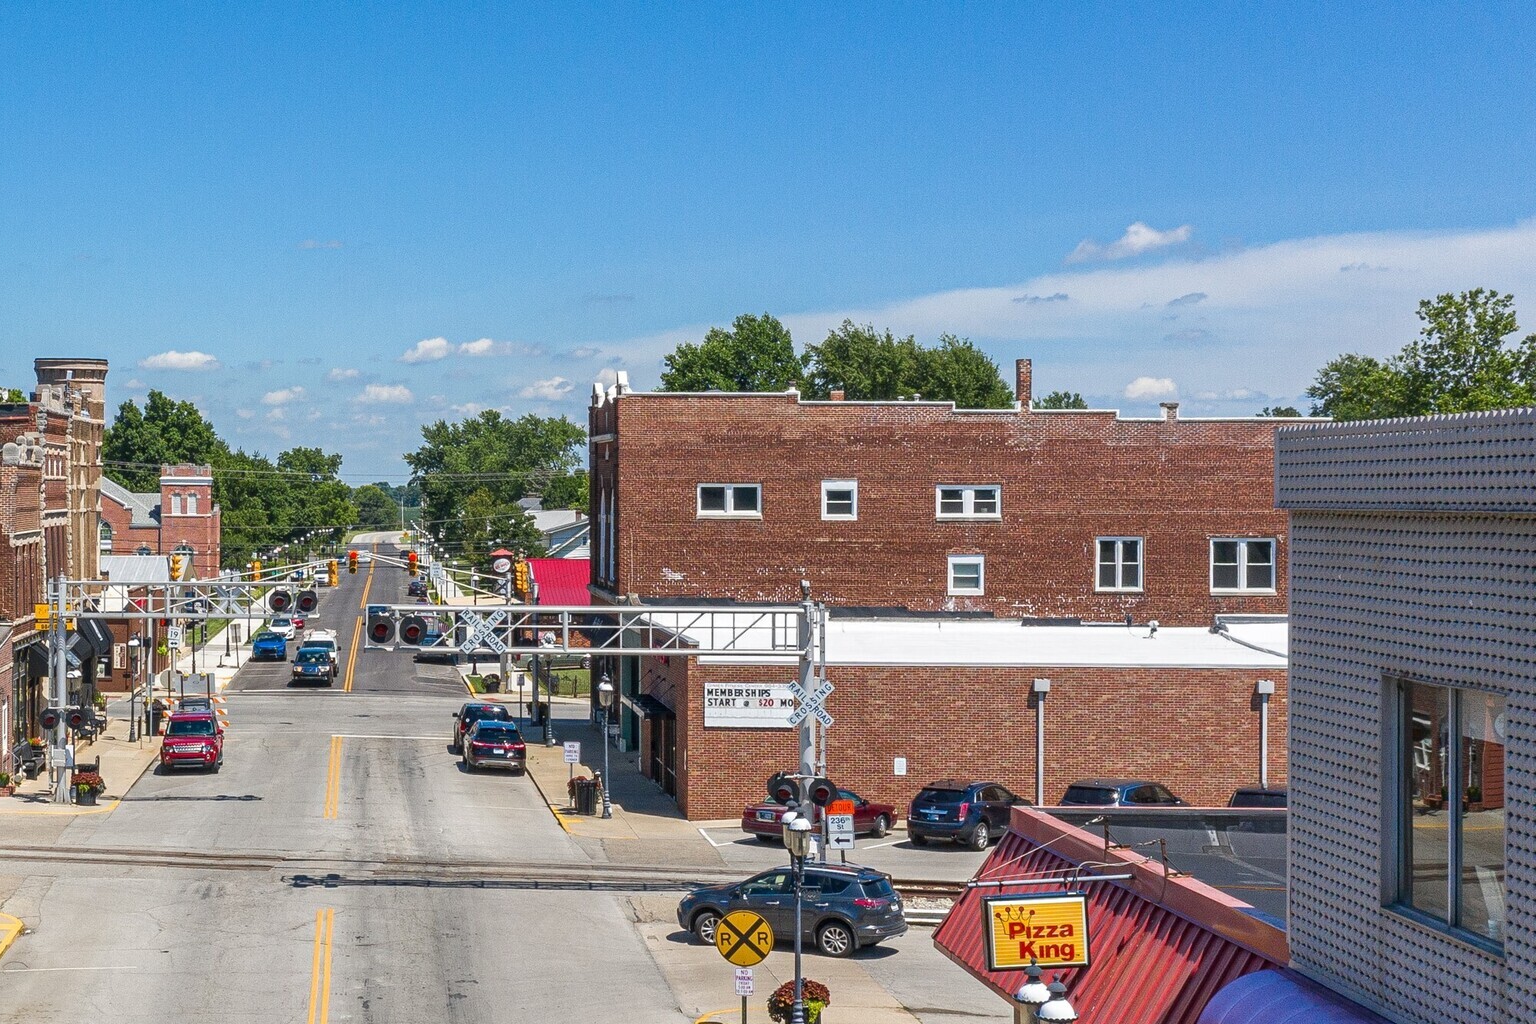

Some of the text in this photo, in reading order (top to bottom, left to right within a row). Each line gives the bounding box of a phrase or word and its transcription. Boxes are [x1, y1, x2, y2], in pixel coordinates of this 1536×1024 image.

[170, 630, 179, 639] 19
[463, 610, 504, 651] CROSSING
[706, 688, 771, 697] MEMBERSHIPS
[707, 698, 736, 706] START
[758, 698, 774, 706] $20
[789, 683, 832, 726] CROSSING
[720, 931, 769, 946] R R
[1008, 922, 1074, 940] Pizza
[1019, 940, 1075, 961] King
